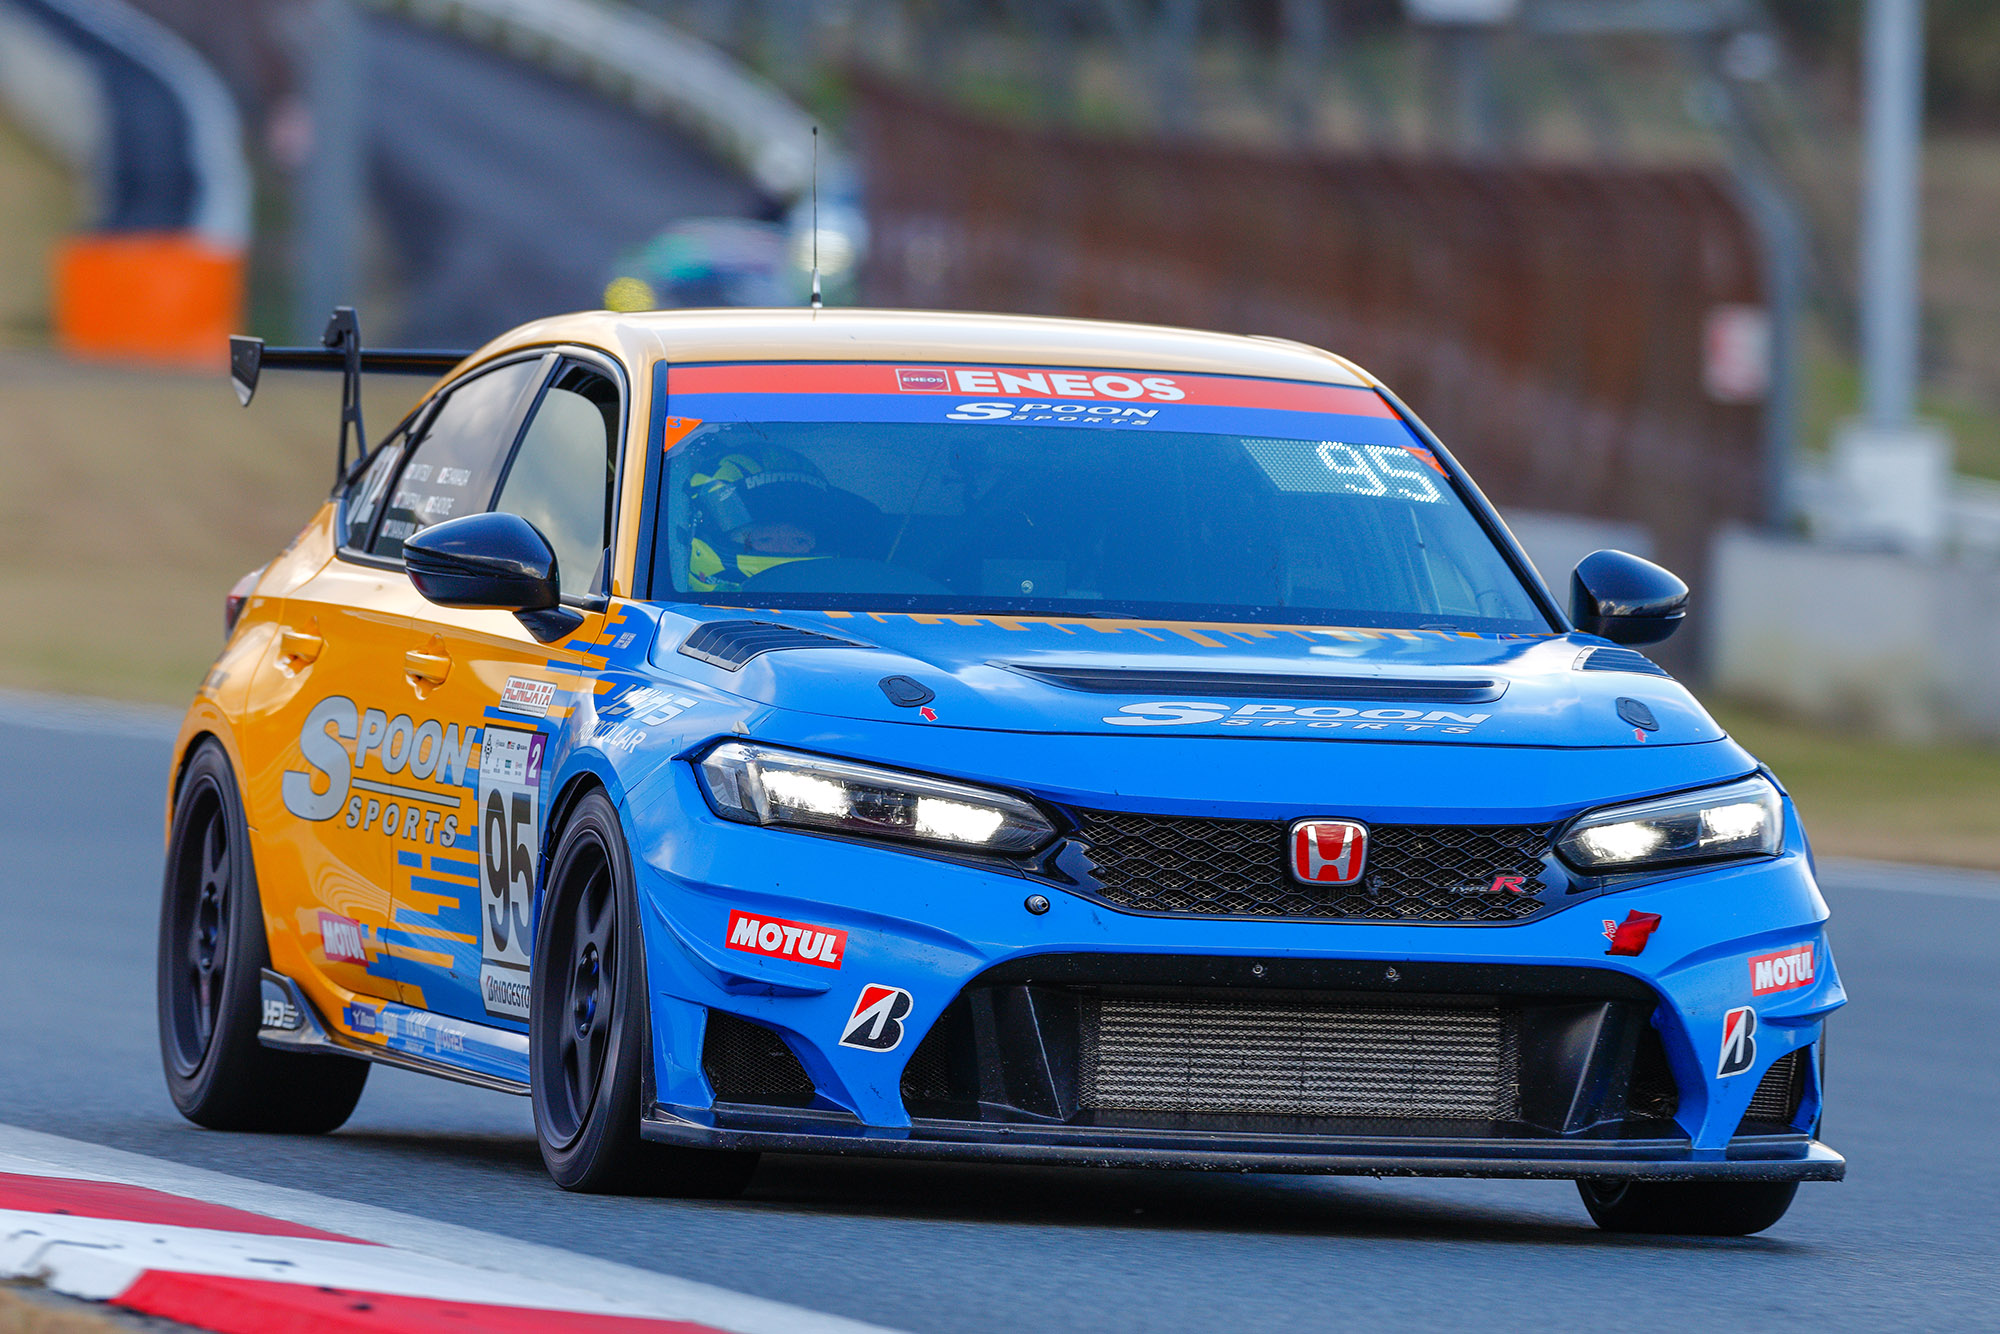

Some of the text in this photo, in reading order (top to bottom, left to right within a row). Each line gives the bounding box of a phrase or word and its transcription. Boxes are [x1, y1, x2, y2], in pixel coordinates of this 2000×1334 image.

[954, 370, 1186, 401] ENEOS
[946, 402, 1159, 421] SPOON
[1010, 415, 1150, 425] SPORTS
[1316, 440, 1440, 503] 95
[1102, 701, 1492, 726] SPOON
[1219, 719, 1475, 734] SPORTS
[281, 695, 477, 822] SPOON
[528, 743, 541, 778] 2
[345, 796, 458, 847] SPORTS
[485, 788, 535, 957] 95
[1488, 876, 1527, 895] R
[321, 920, 366, 961] MOTUL
[730, 917, 840, 963] MOTUL
[1754, 951, 1813, 991] MOTUL
